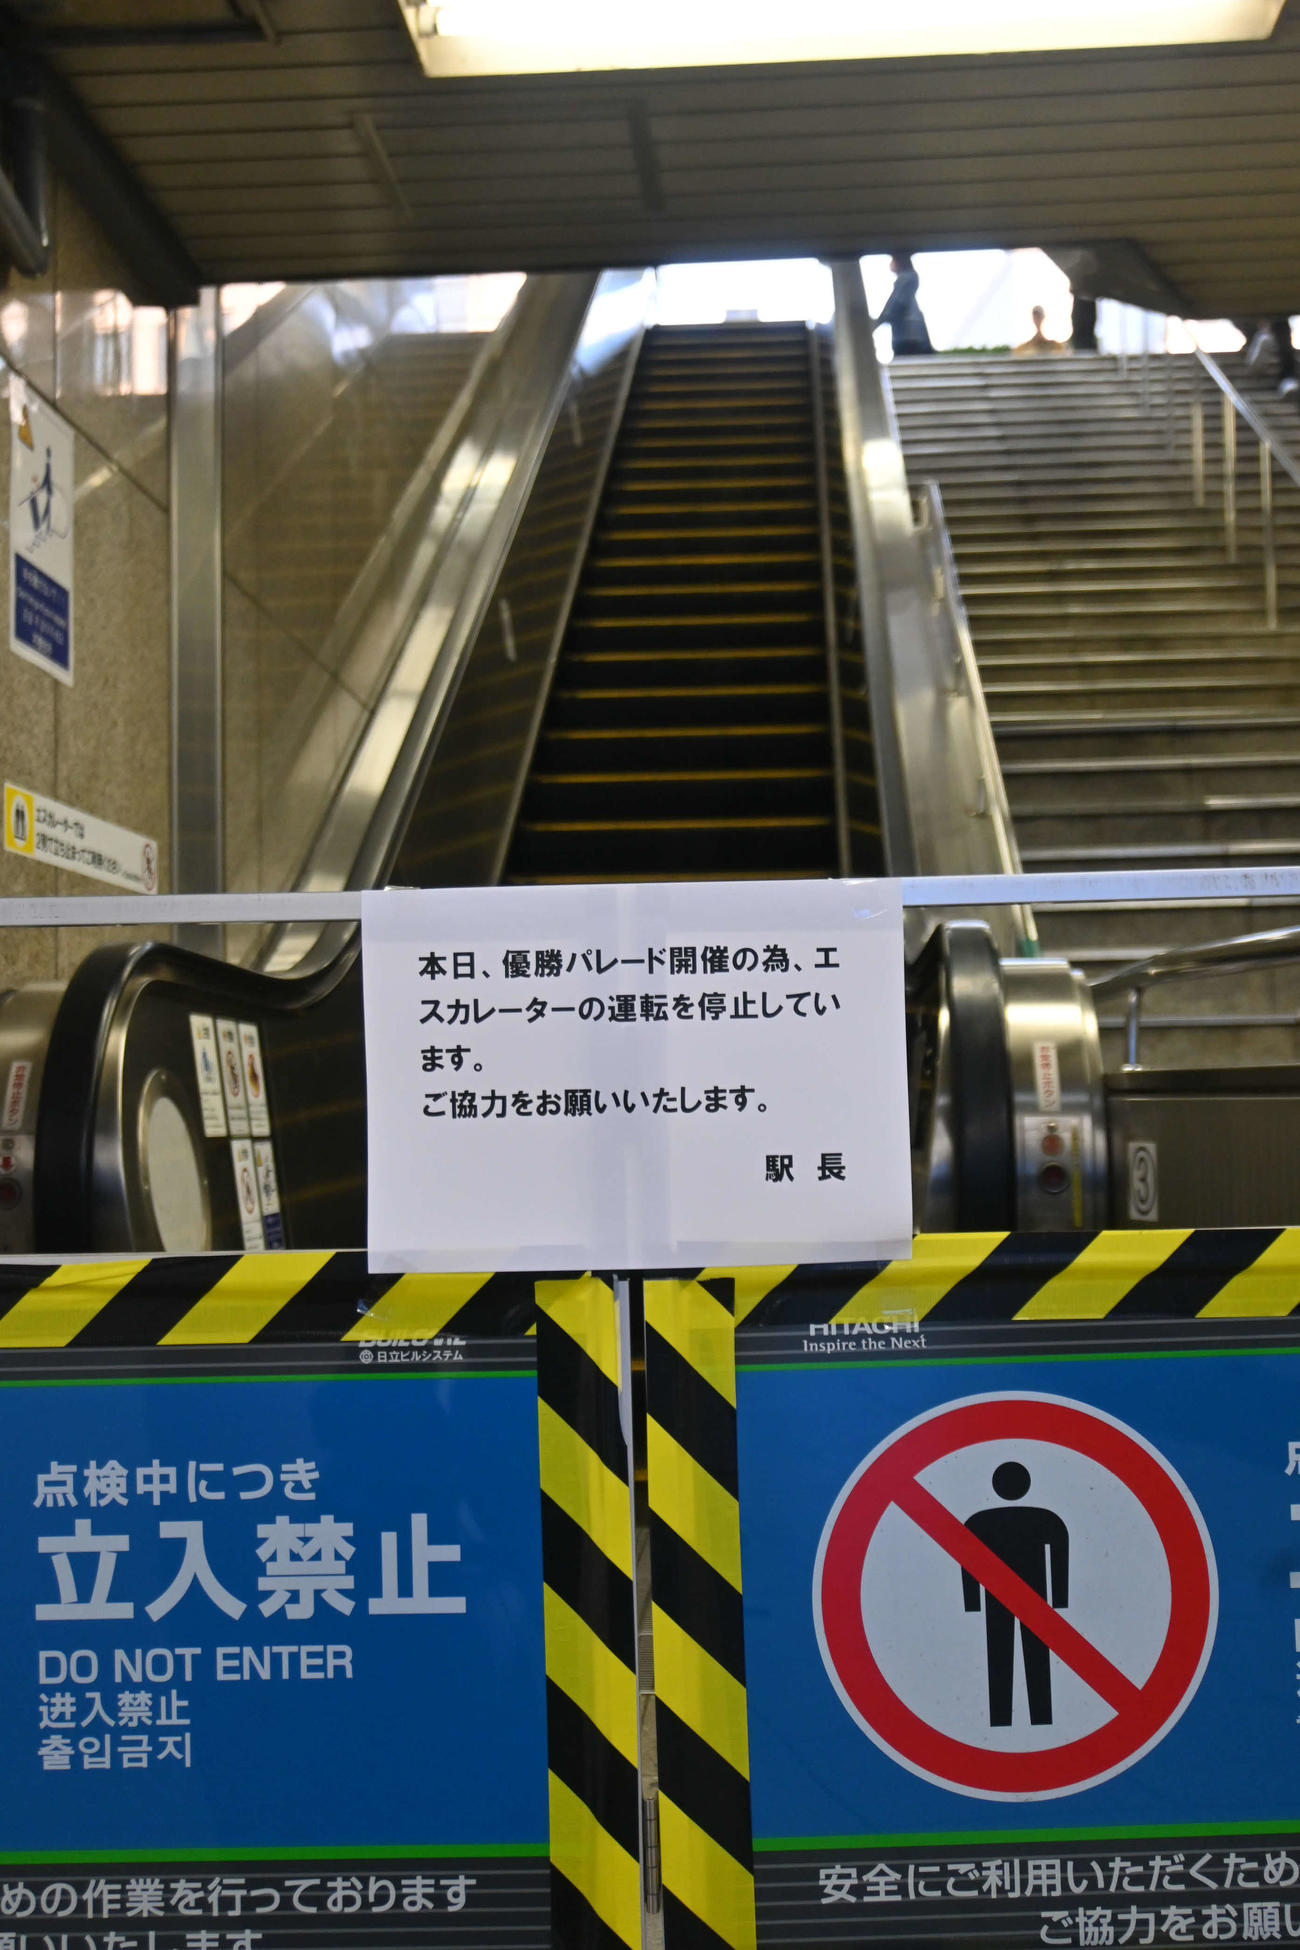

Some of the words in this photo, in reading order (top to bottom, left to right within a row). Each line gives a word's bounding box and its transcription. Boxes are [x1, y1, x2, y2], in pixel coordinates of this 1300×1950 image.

[418, 944, 840, 981] 本日、優勝パレード開催の為、エ
[419, 991, 841, 1025] スカレーターの運転を停止してい
[420, 1044, 483, 1073] ます。
[422, 1084, 767, 1119] ご協力をお願いいたします。
[376, 1350, 464, 1363] 日立ビルシステム
[803, 1339, 857, 1354] Inspire
[861, 1337, 886, 1350] the
[890, 1334, 928, 1350] Next
[33, 1458, 320, 1508] 点検中につき
[35, 1513, 467, 1622] 立入禁止
[38, 1649, 98, 1684] DO
[114, 1647, 202, 1683] NOT
[216, 1645, 353, 1681] ENTER
[39, 1689, 191, 1729] 进入禁止
[38, 1732, 192, 1770] 출입금지
[818, 1850, 1300, 1904] 安全にご利用いただくため
[0, 1875, 477, 1919] めの作業を行っております
